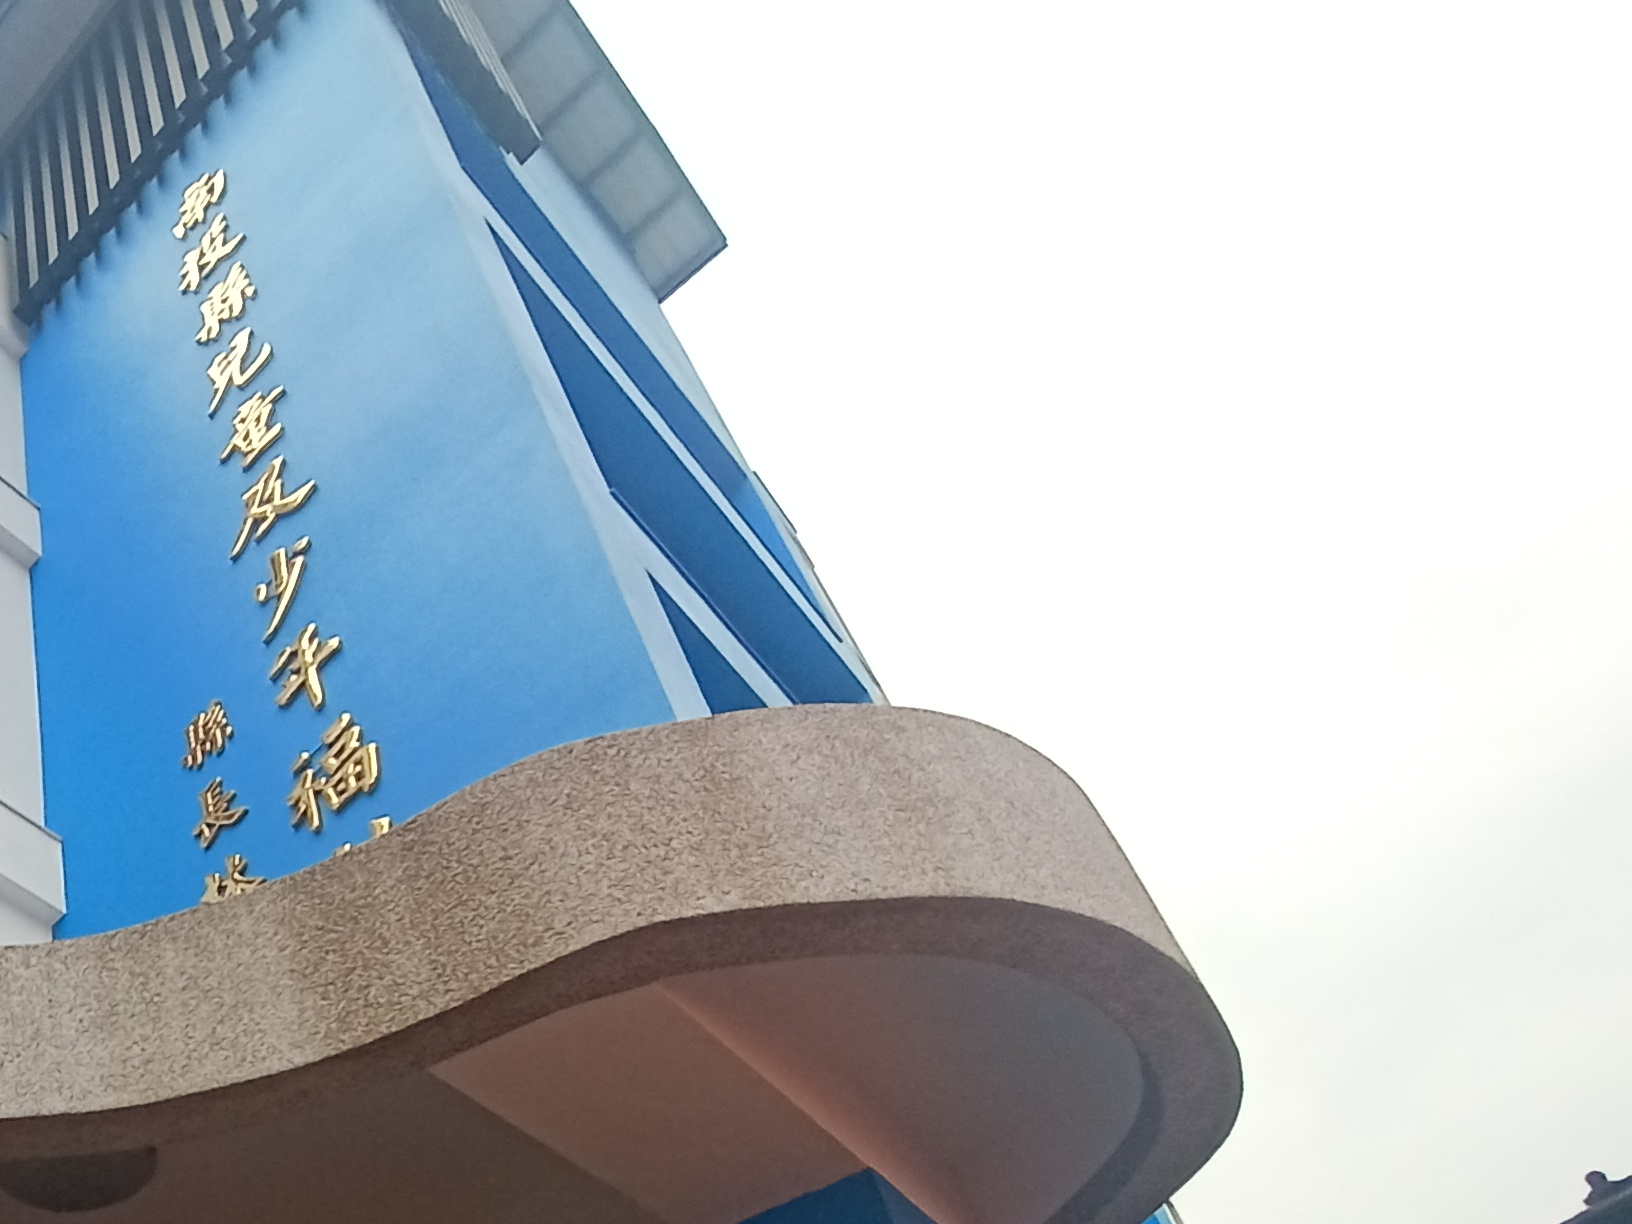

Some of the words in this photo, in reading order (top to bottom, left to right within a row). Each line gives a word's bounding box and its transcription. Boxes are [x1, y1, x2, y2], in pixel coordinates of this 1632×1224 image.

[172, 168, 392, 856] 南投縣兒童及少年福
